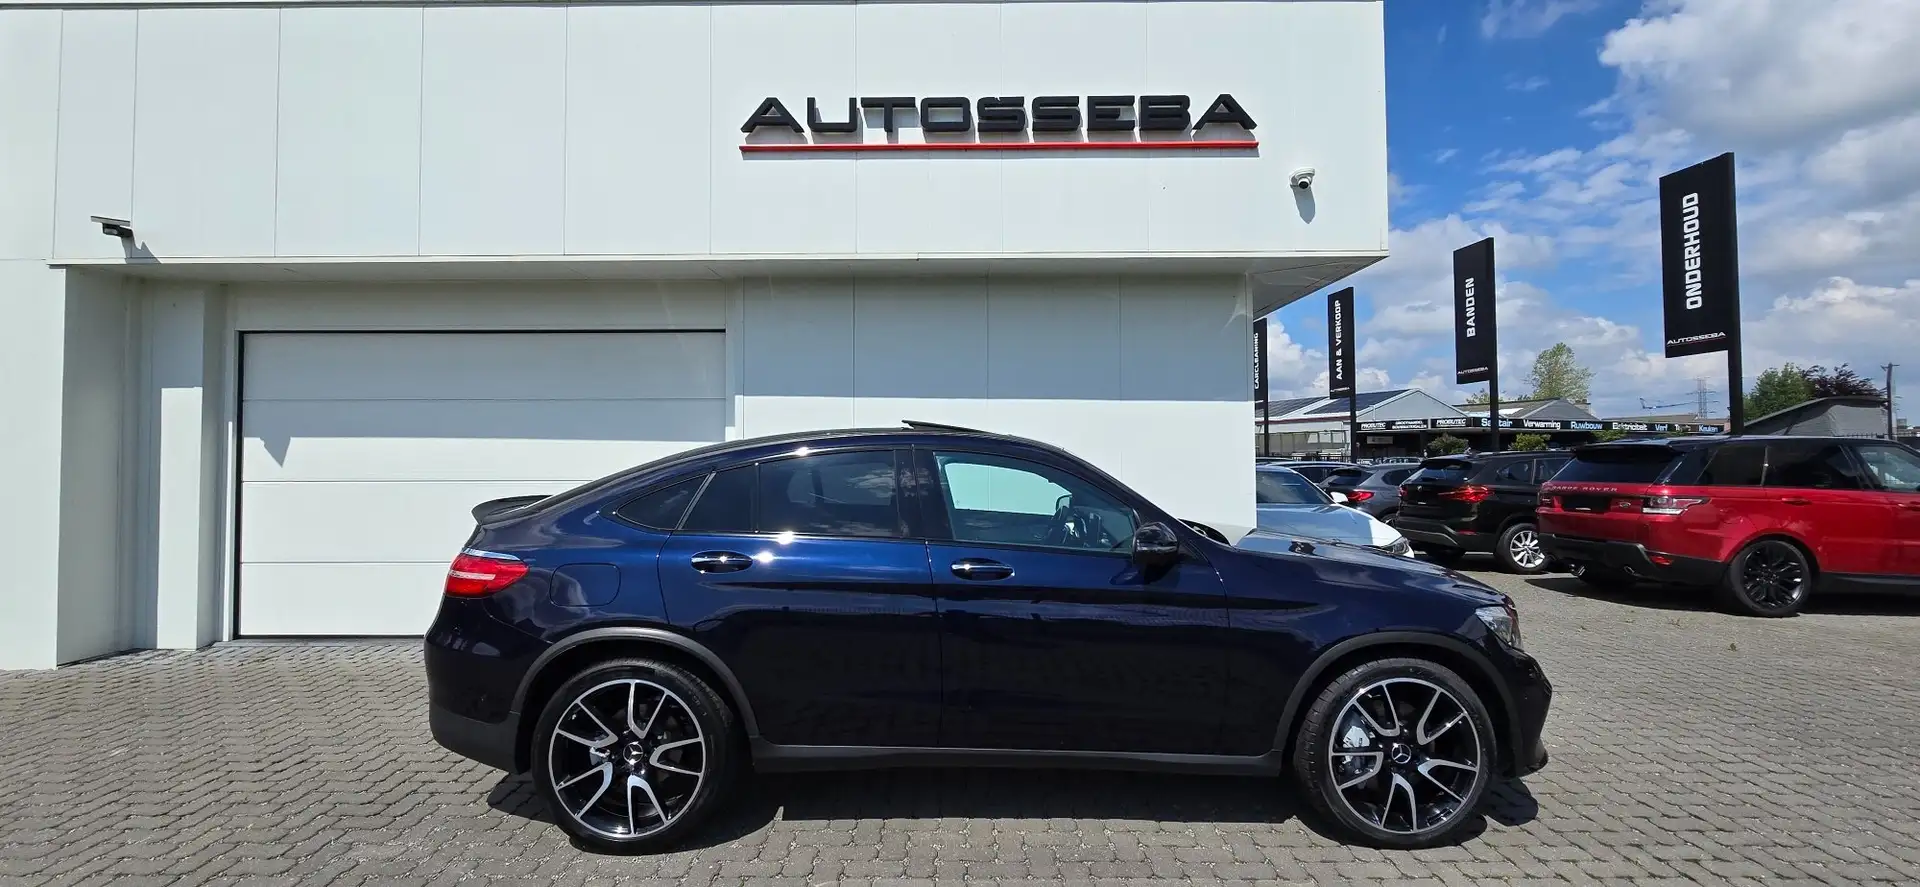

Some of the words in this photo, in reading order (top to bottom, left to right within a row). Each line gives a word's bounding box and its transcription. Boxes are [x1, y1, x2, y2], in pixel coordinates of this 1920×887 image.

[740, 94, 1258, 133] AUTOSSEBA
[1683, 192, 1702, 310] ONDERHOUD
[1465, 277, 1476, 338] BANDEN
[1667, 331, 1726, 346] AUTOSSEBA
[1336, 348, 1342, 356] &
[1481, 418, 1512, 427] Satair
[1523, 419, 1561, 429] Verwarming
[1571, 421, 1603, 430] Ruwbouw
